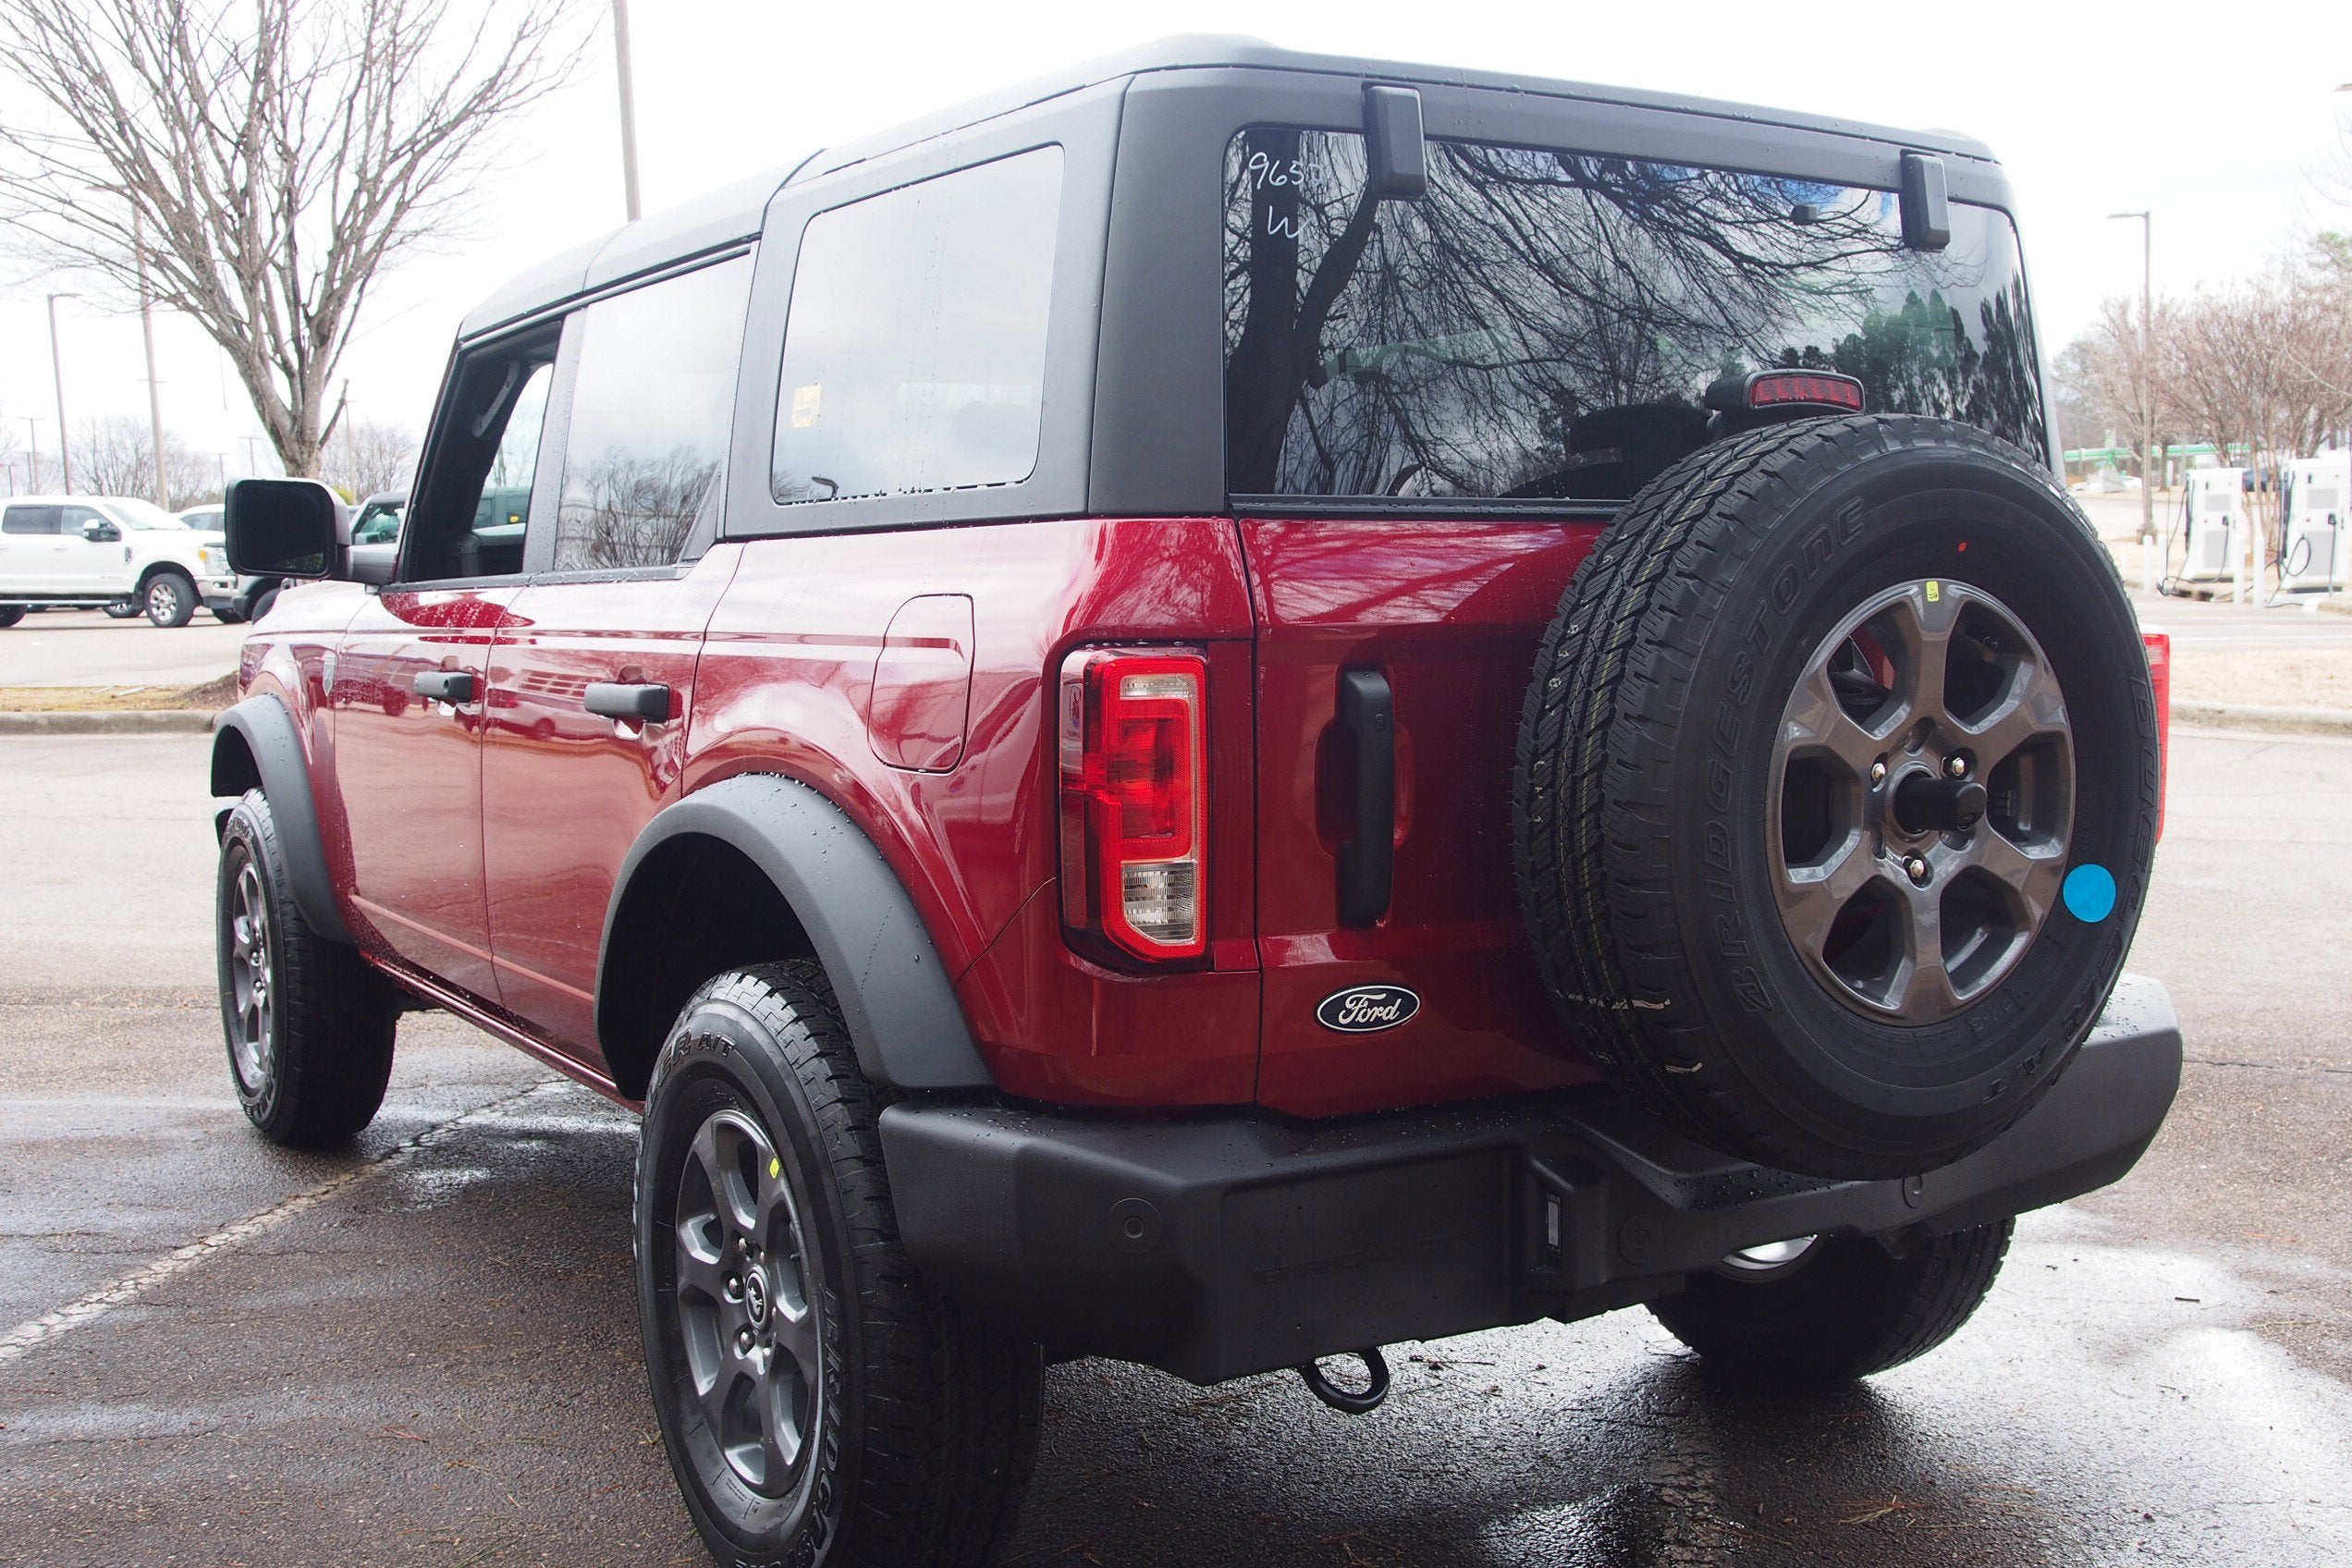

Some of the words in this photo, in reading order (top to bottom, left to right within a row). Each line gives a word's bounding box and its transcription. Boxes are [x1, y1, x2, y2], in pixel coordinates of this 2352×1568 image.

[1704, 495, 1865, 1014] BRIDGESTONE
[1338, 993, 1403, 1024] Ford
[697, 1029, 736, 1058] A/T
